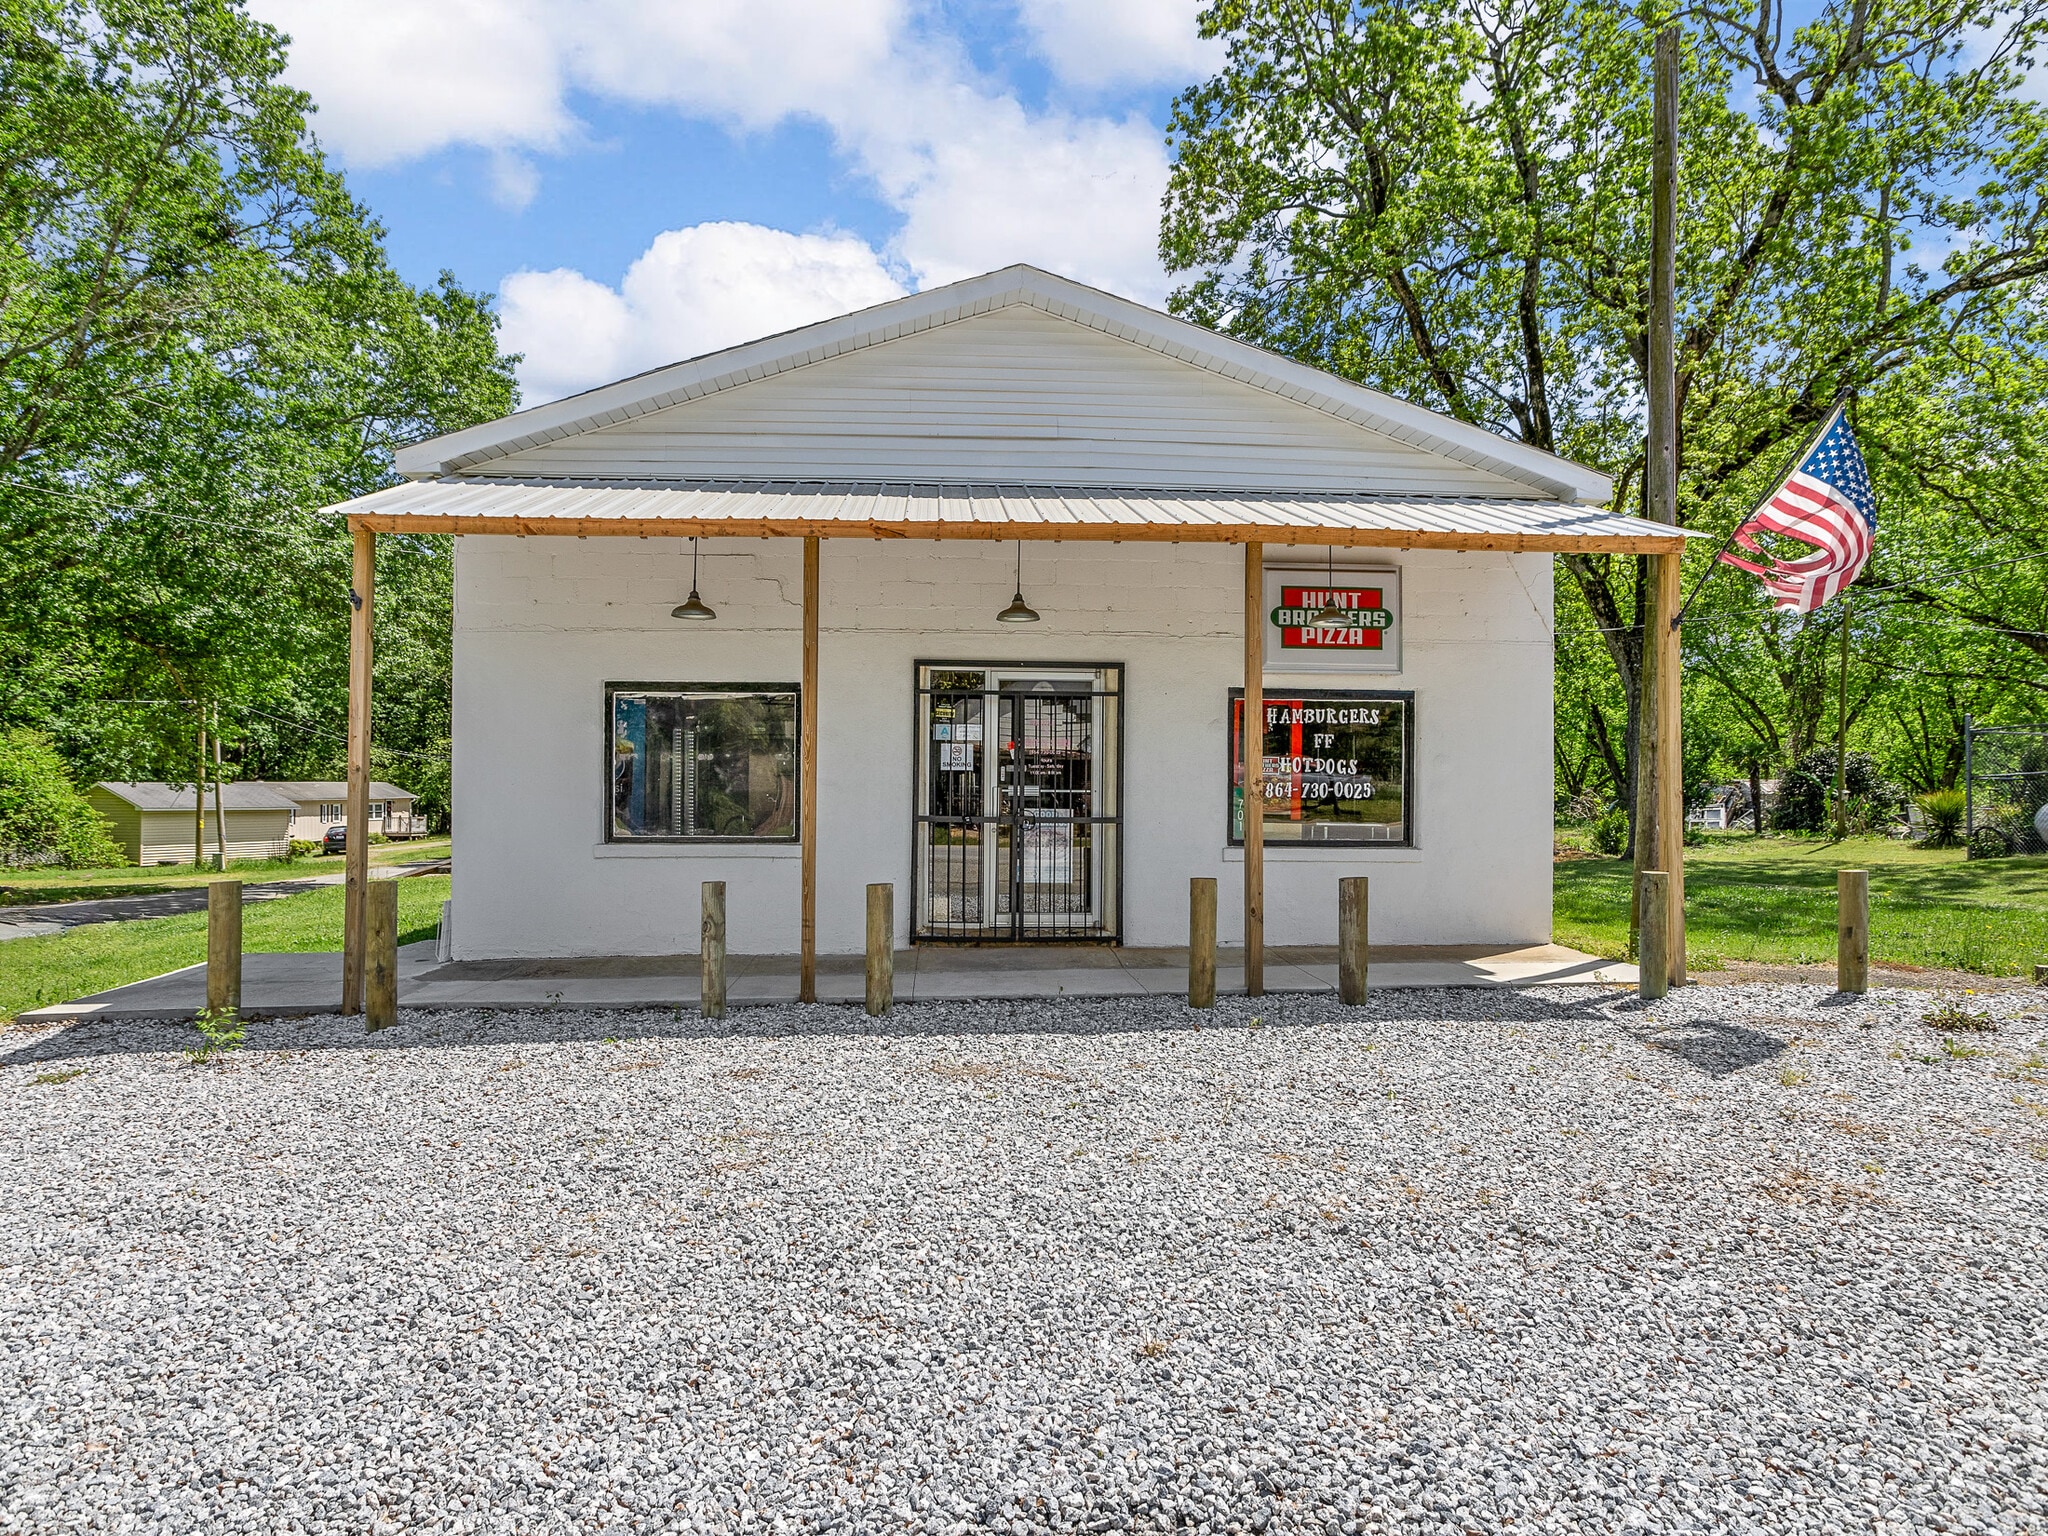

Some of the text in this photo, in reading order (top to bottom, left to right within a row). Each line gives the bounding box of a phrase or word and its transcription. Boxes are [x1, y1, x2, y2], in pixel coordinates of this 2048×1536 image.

[1302, 591, 1361, 609] HUNT
[1278, 609, 1386, 627] BROERS
[1301, 627, 1363, 645] PIZZA
[1267, 708, 1380, 725] HAMBURGERS
[941, 727, 949, 735] A
[1314, 734, 1334, 748] FF
[1265, 782, 1371, 799] 864-730-0025
